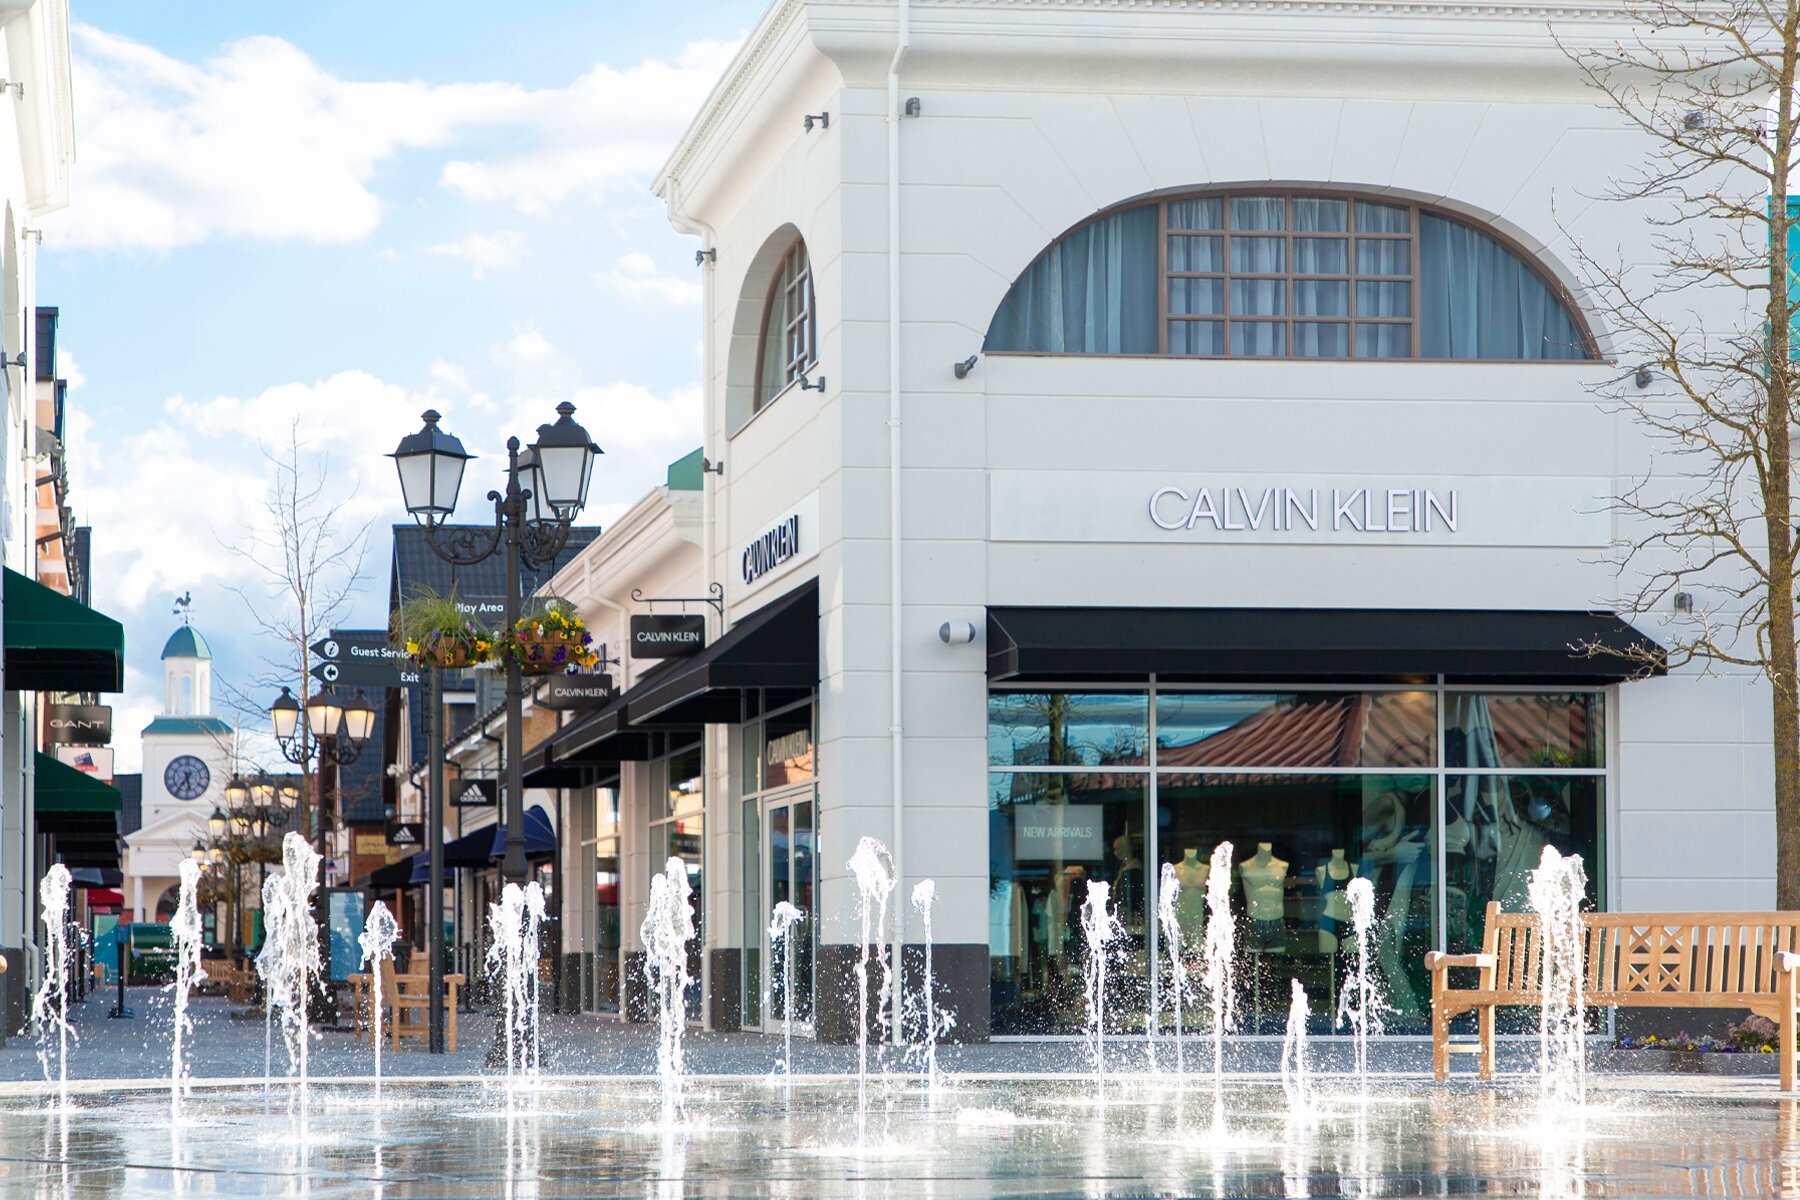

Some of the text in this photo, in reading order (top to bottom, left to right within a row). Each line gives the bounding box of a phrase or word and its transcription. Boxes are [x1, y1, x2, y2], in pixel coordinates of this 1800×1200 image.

[1149, 486, 1457, 532] CALVIN KLEIN
[455, 602, 504, 616] Play Area
[636, 631, 700, 642] CALVIN KLEIN
[350, 645, 416, 660] Guest Servic
[400, 671, 420, 683] Exit
[554, 687, 609, 698] CALVIN KLEIN
[49, 719, 105, 729] GANT
[1023, 826, 1093, 839] NEW ARRIVALS
